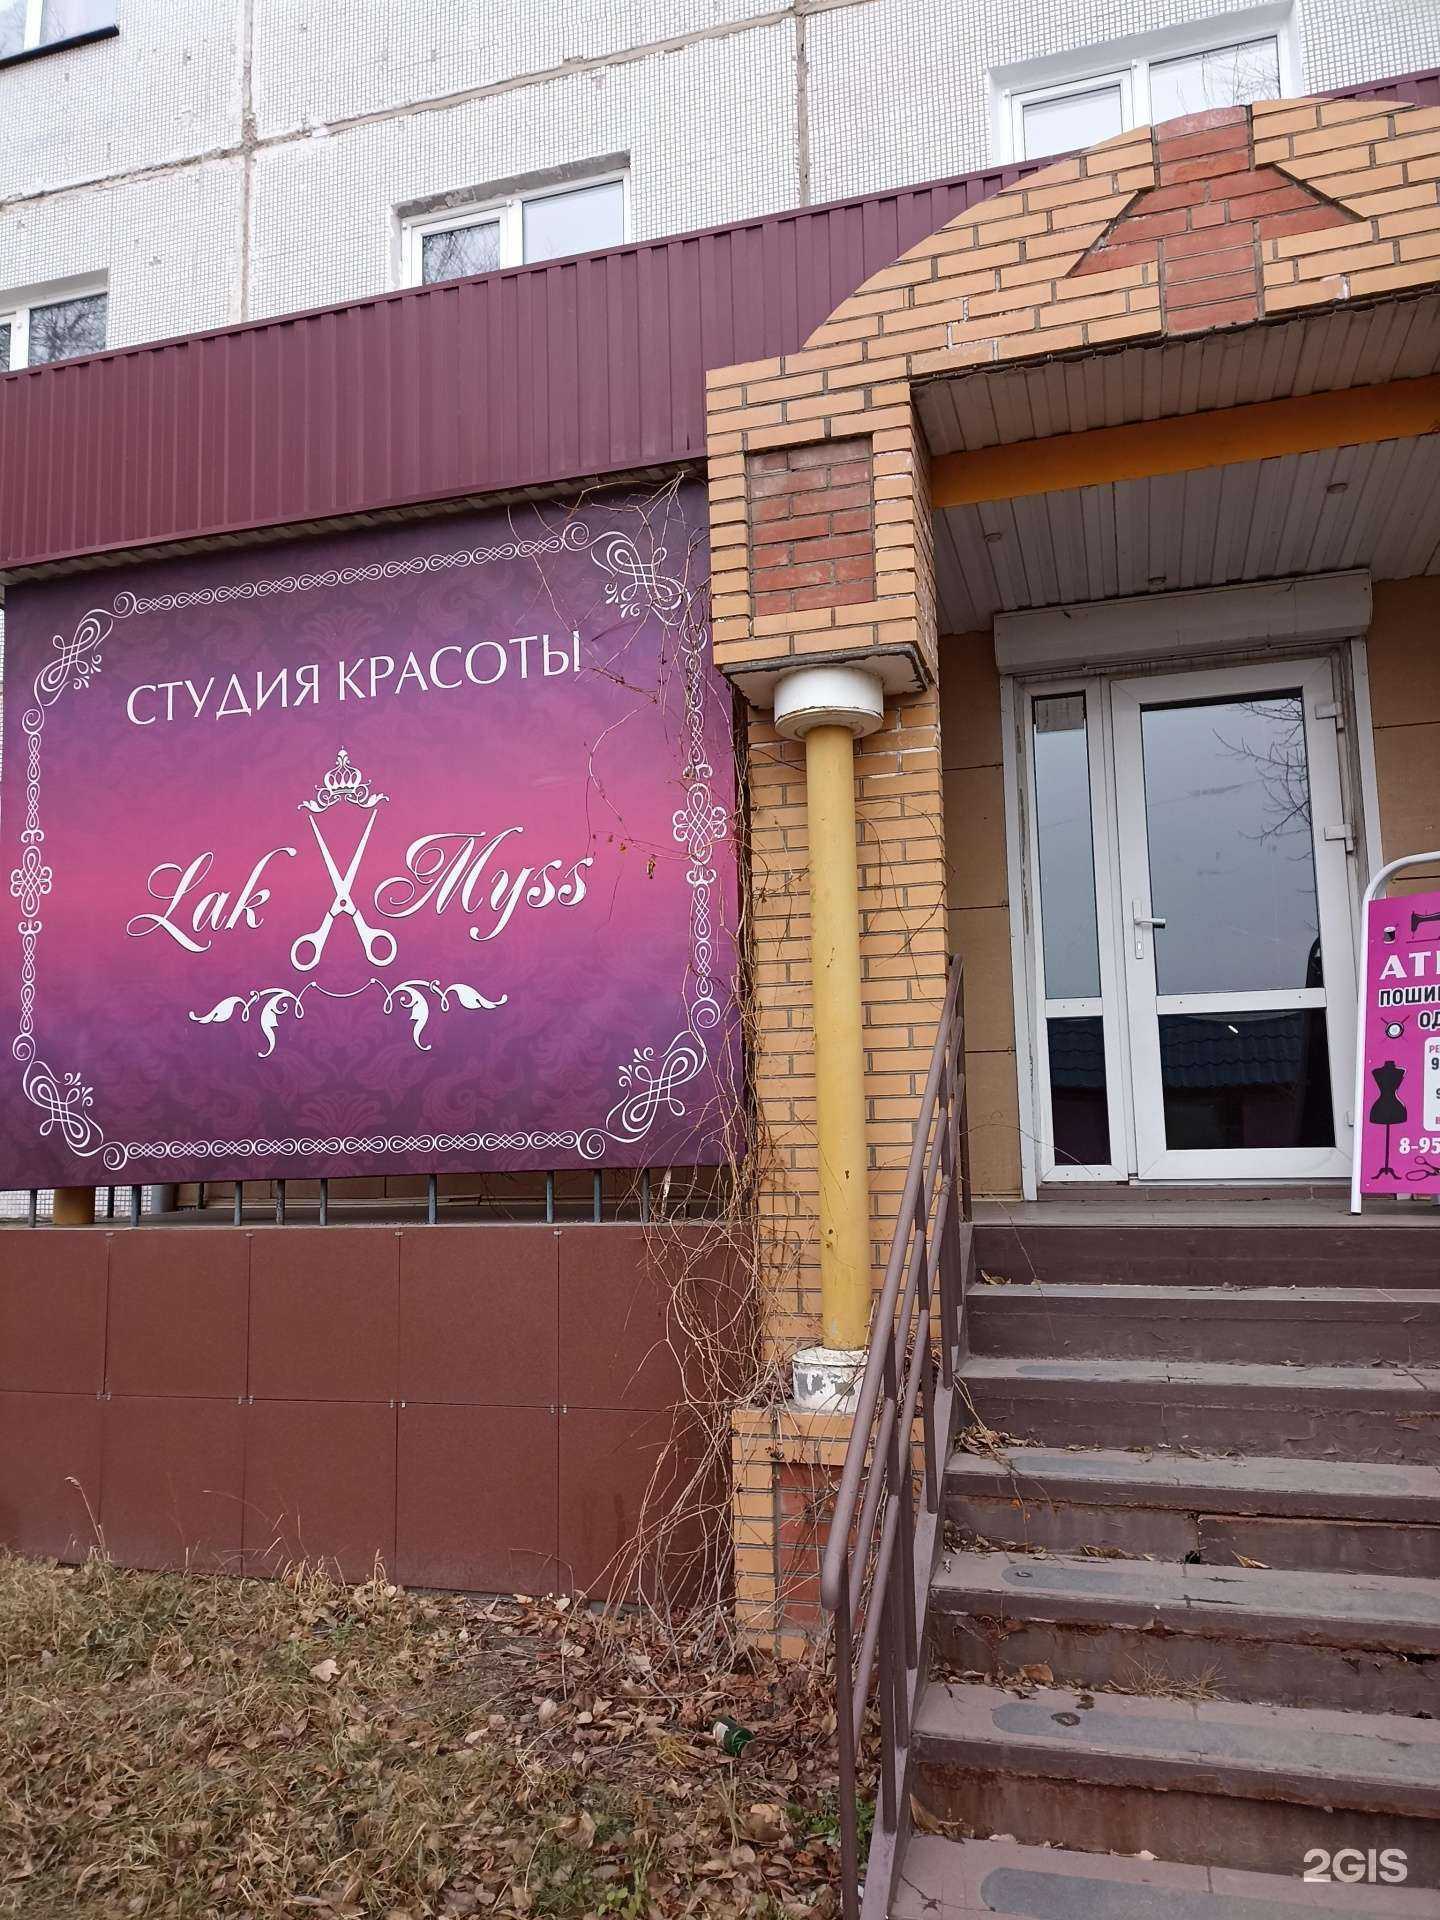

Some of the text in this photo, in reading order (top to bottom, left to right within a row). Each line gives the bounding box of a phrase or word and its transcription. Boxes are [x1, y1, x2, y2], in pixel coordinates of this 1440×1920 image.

[126, 631, 581, 725] СТУДИЯ КРАСОТЫ
[126, 826, 595, 953] Lak Myss
[1379, 951, 1440, 980] АТ
[1379, 985, 1440, 1007] ПОШИ
